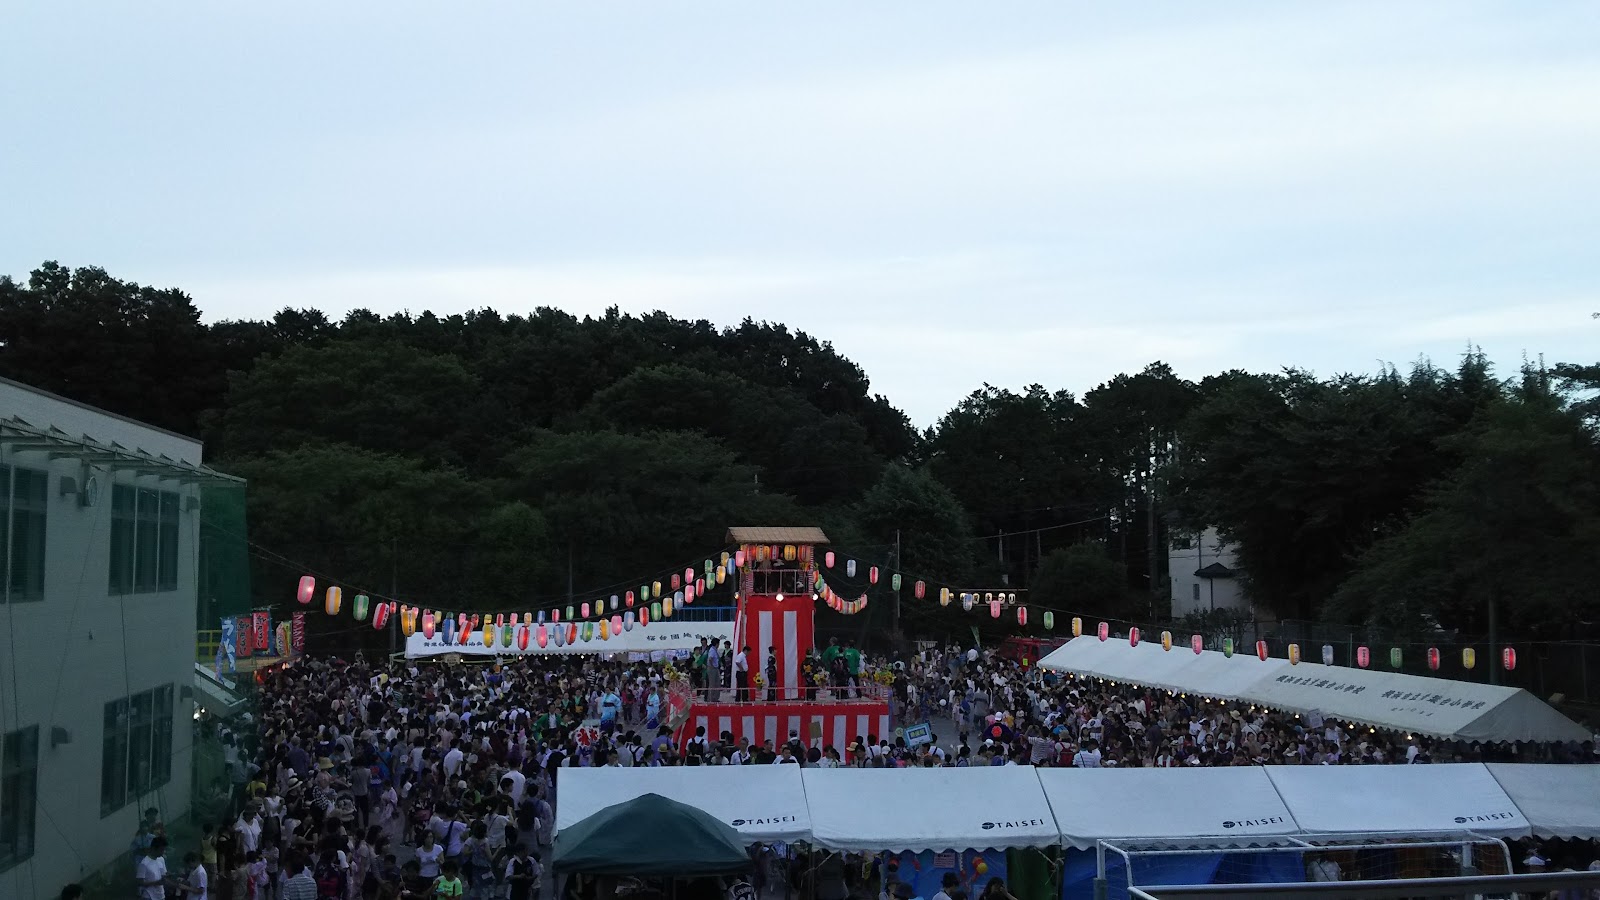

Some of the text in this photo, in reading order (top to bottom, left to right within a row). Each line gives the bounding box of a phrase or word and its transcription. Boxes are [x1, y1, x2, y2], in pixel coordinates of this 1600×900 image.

[746, 816, 796, 826] TAISEI
[1236, 816, 1284, 828] TAISEI
[1466, 811, 1514, 823] TAISEI
[995, 818, 1044, 829] TAISEI
